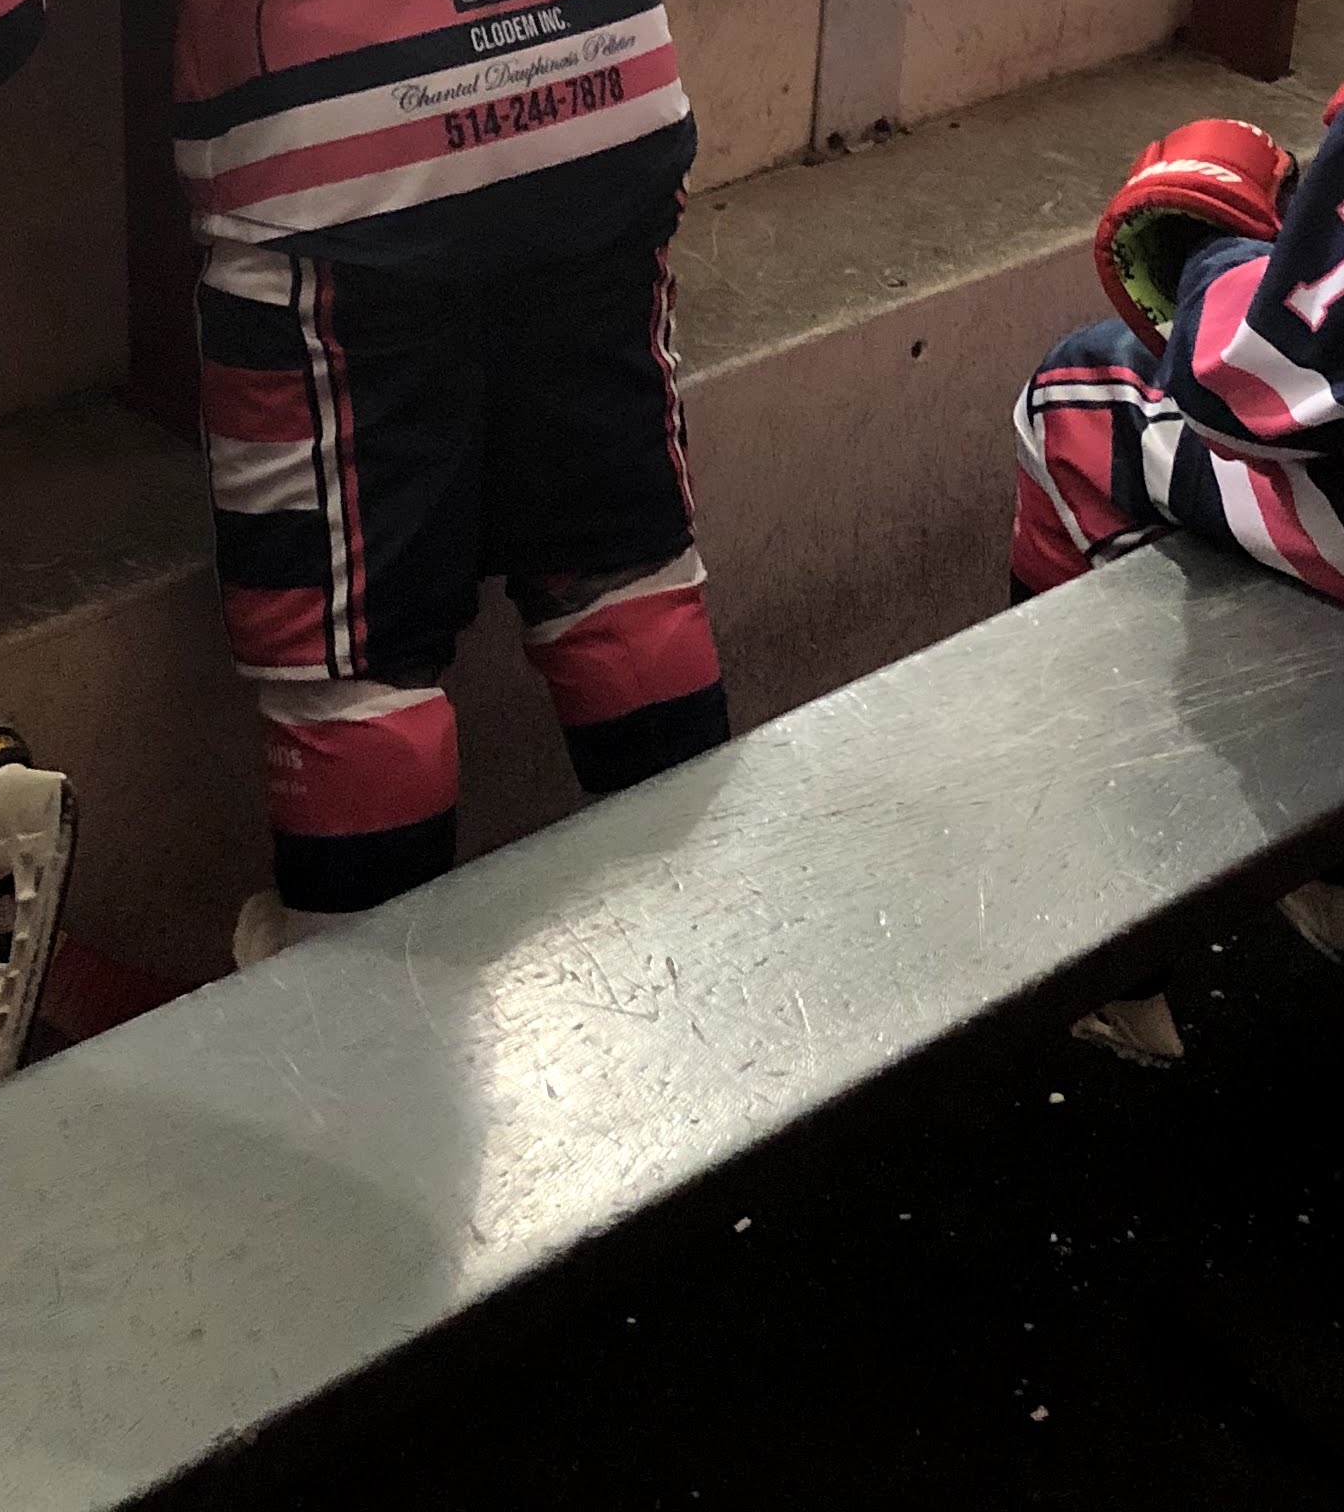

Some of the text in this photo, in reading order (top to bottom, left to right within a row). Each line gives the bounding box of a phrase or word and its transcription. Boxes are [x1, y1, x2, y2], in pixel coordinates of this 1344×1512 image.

[470, 5, 572, 54] CLODEM INC.
[444, 66, 626, 150] 514-244-7878
